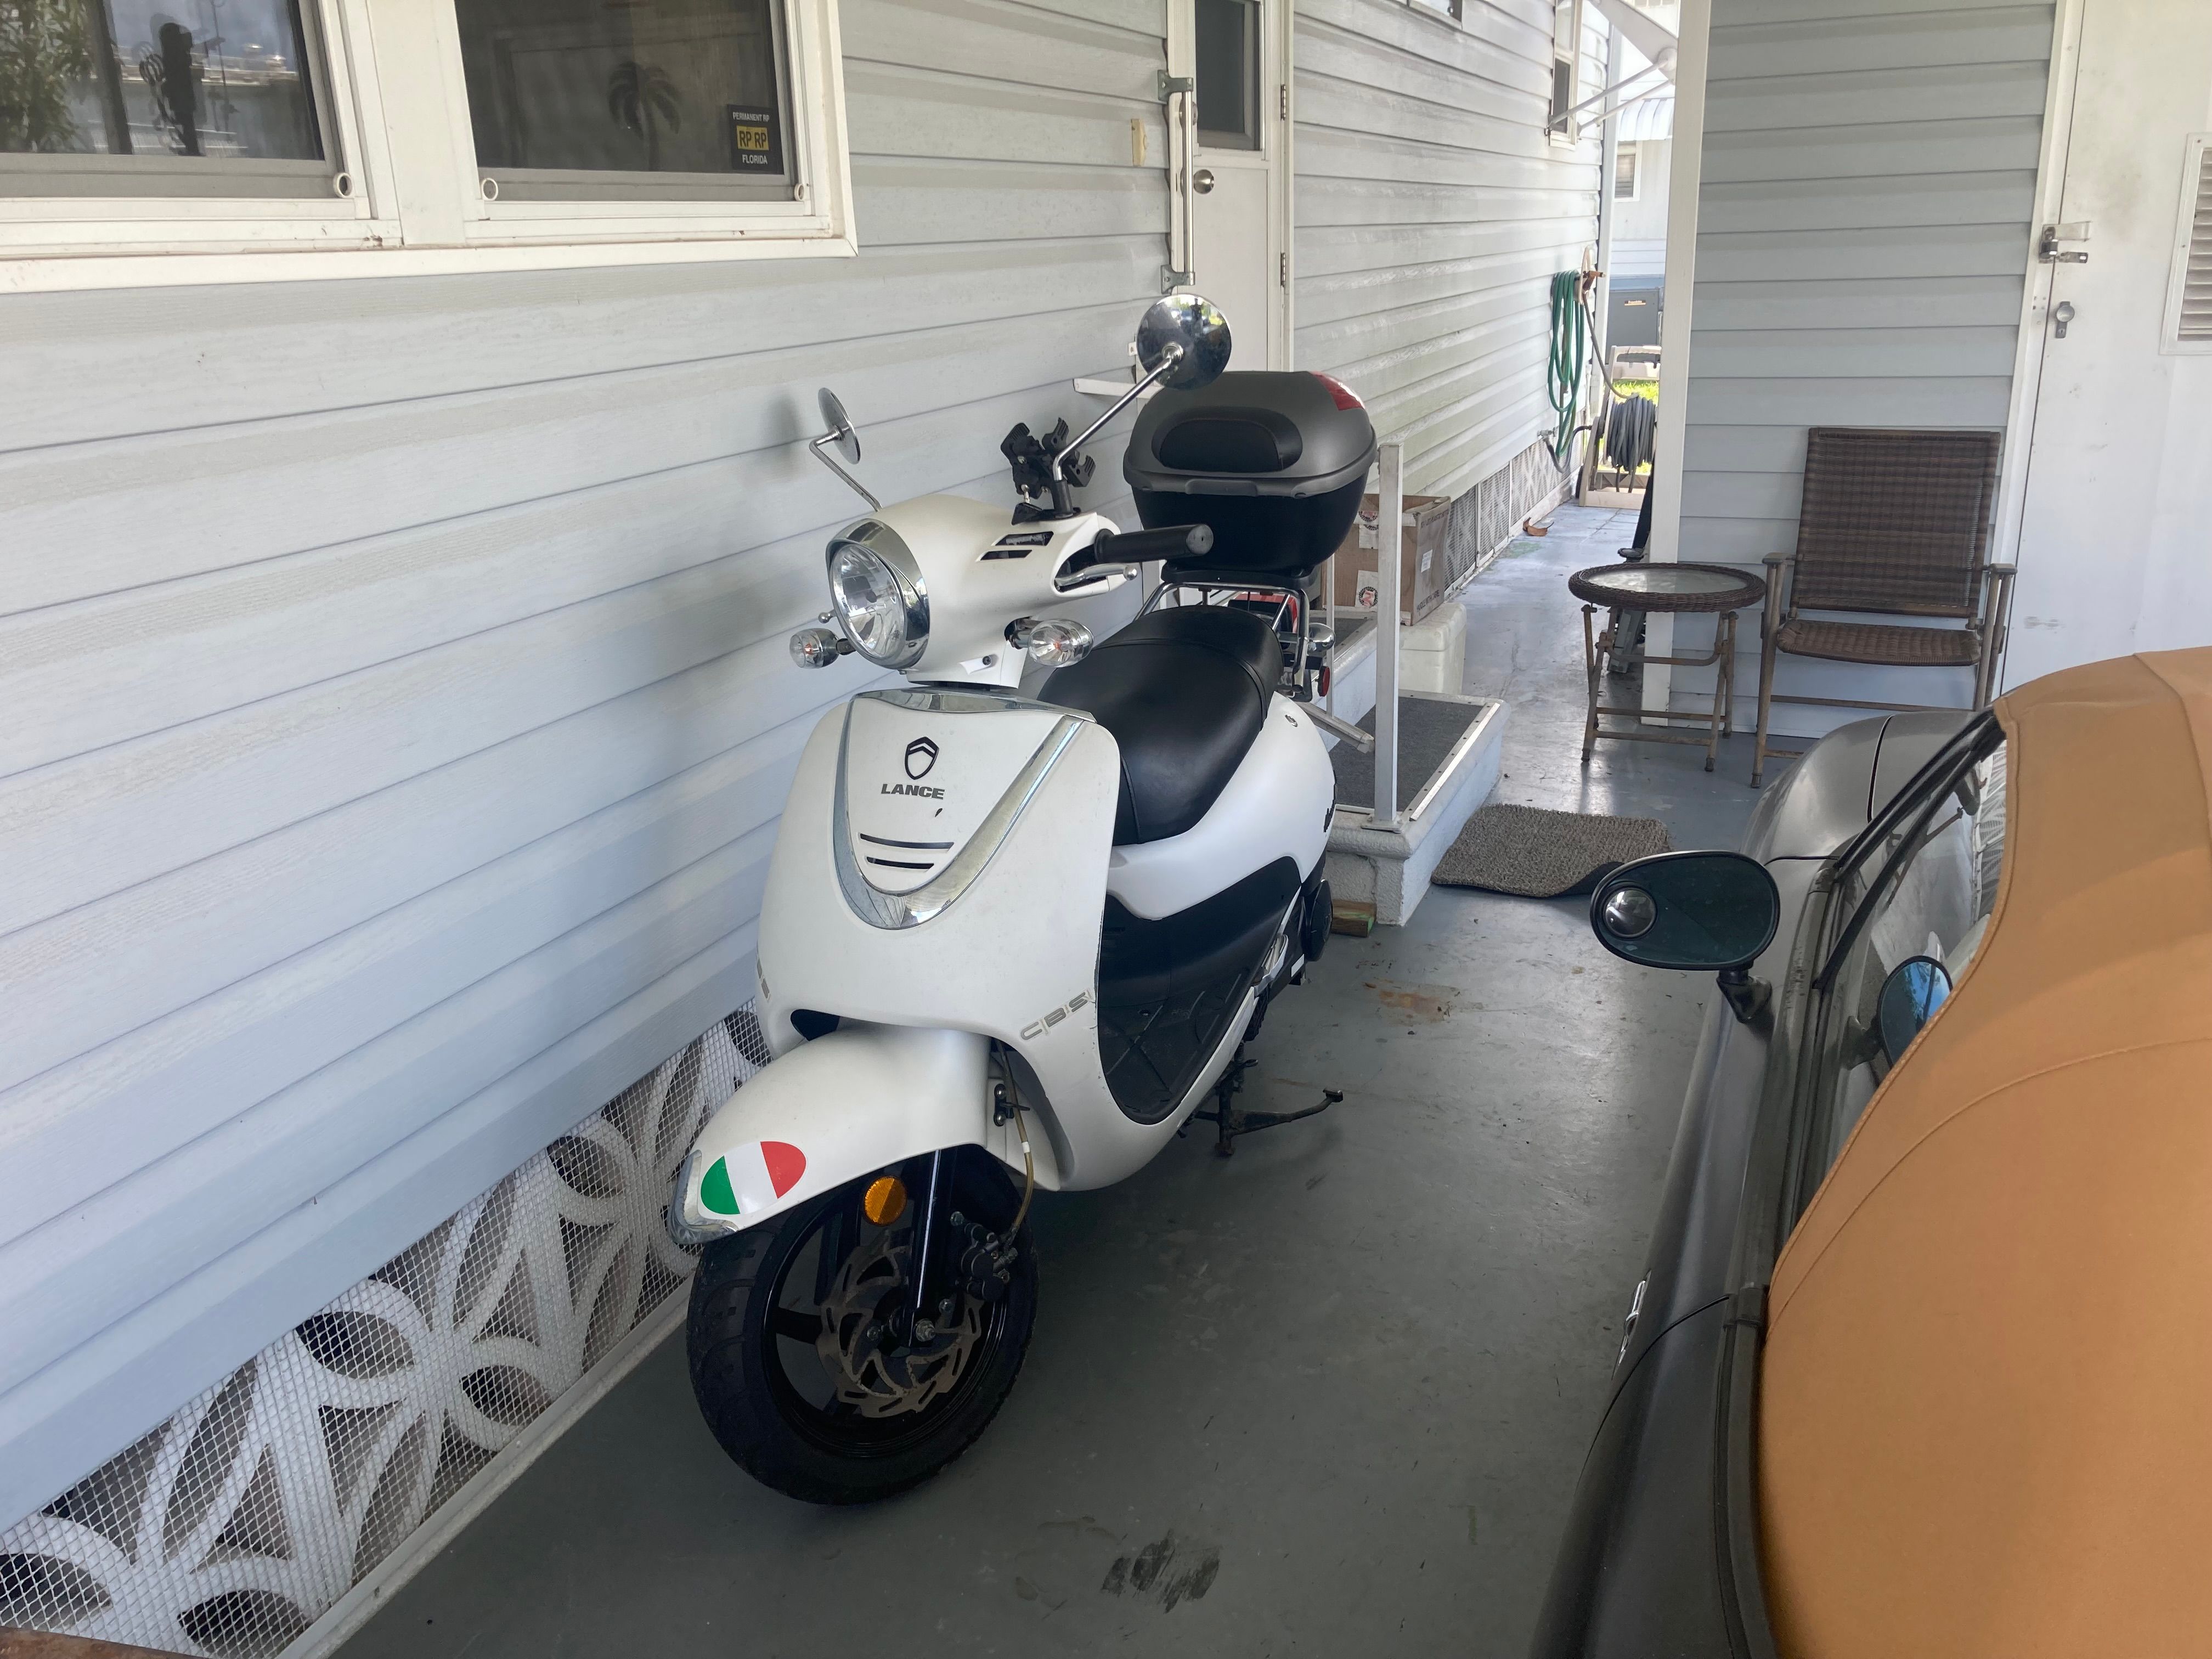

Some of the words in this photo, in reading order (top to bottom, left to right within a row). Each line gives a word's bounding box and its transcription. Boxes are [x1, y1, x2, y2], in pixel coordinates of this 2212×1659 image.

[732, 112, 762, 122] PERMANENT
[739, 131, 752, 148] RP
[754, 132, 767, 149] RP
[742, 154, 768, 165] FLORIDA
[881, 783, 945, 800] LANCE
